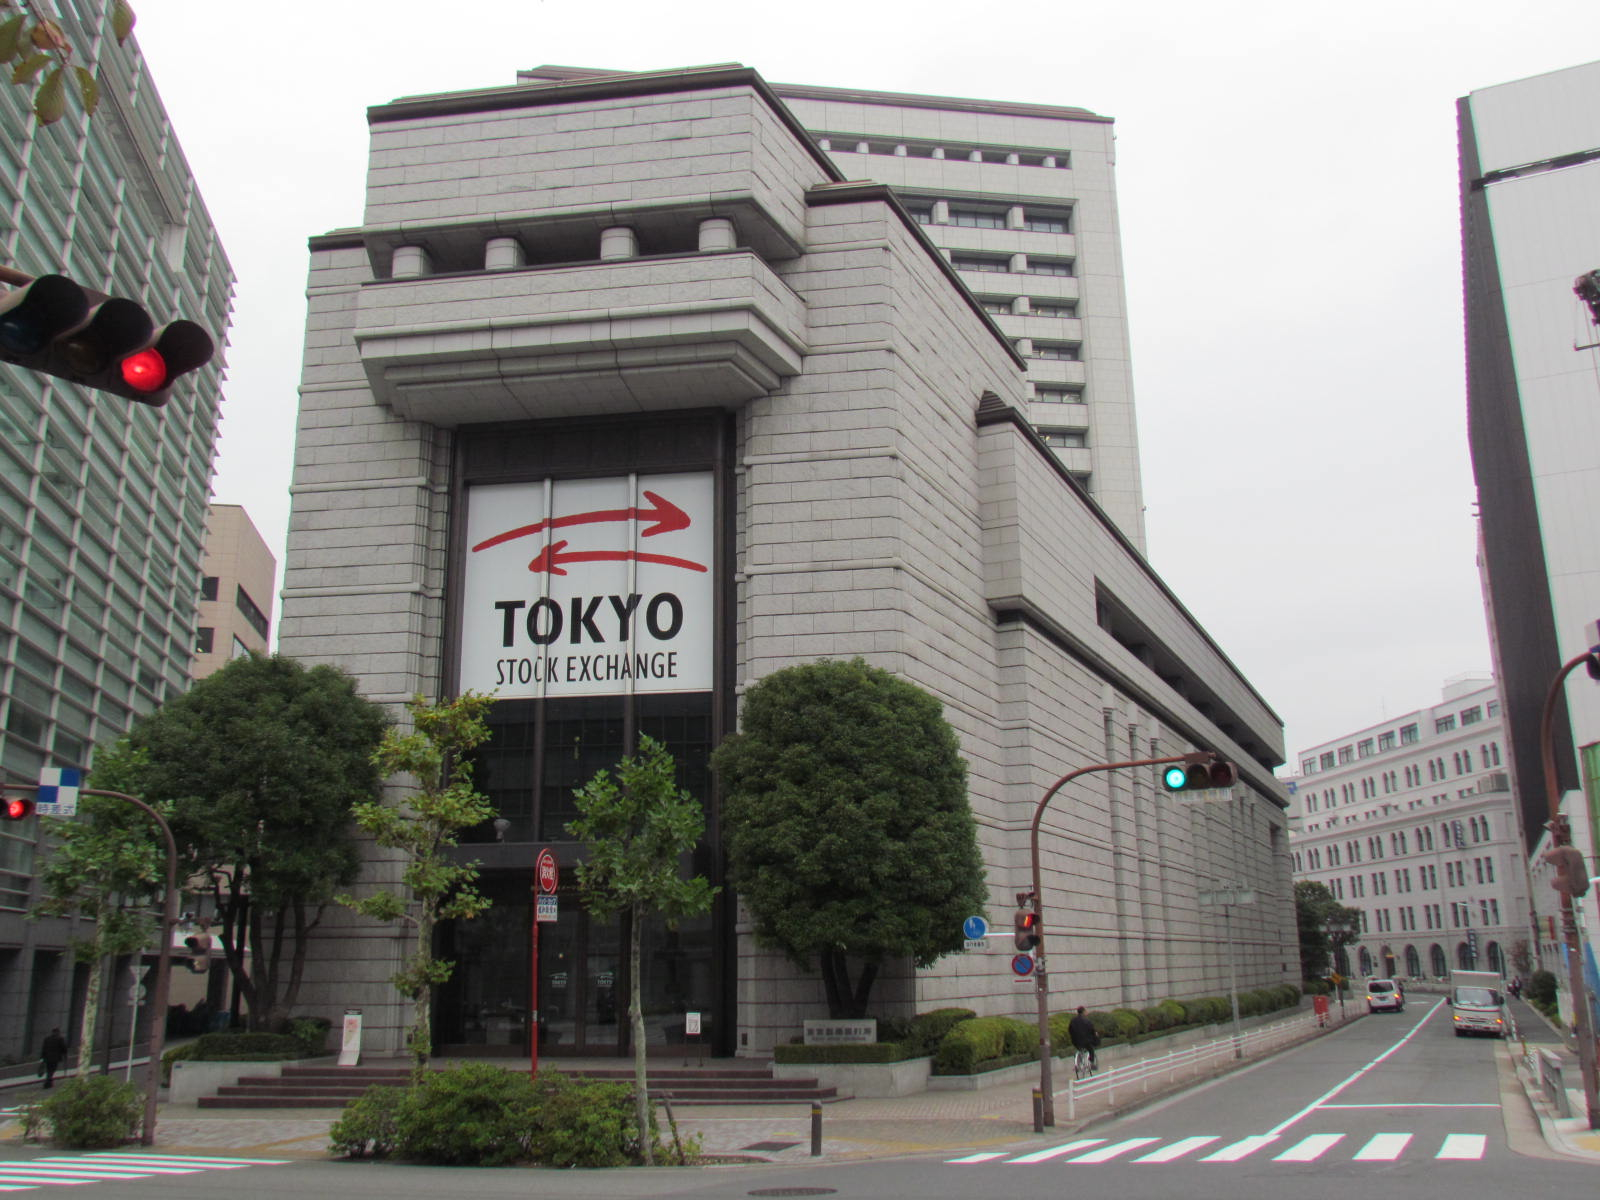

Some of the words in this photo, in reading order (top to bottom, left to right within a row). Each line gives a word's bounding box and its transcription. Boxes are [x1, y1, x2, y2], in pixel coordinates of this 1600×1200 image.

[494, 591, 684, 648] TOKYO
[496, 655, 559, 685] STOCK
[566, 651, 678, 682] EXCHANGE
